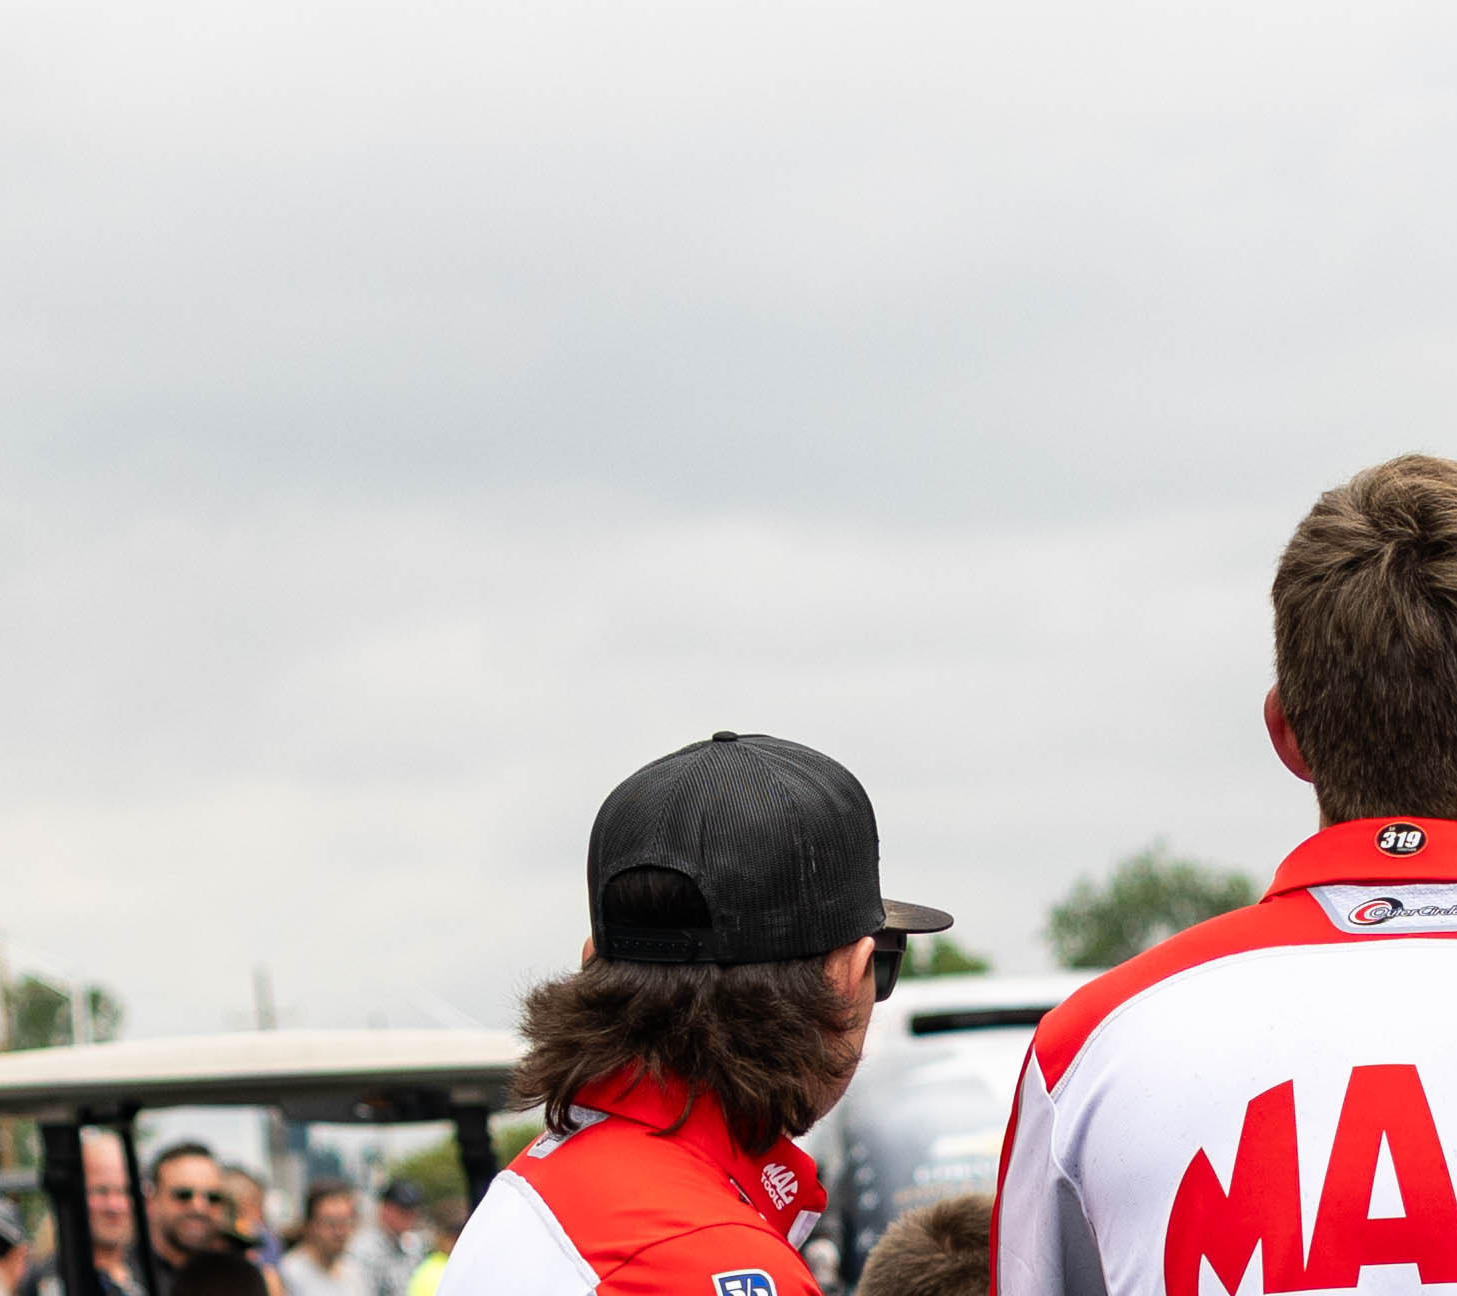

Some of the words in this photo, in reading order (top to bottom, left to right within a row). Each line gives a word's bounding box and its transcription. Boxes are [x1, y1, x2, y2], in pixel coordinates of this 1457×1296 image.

[1380, 831, 1422, 849] 319
[761, 1172, 785, 1211] TOOLS
[763, 1163, 798, 1204] MAC
